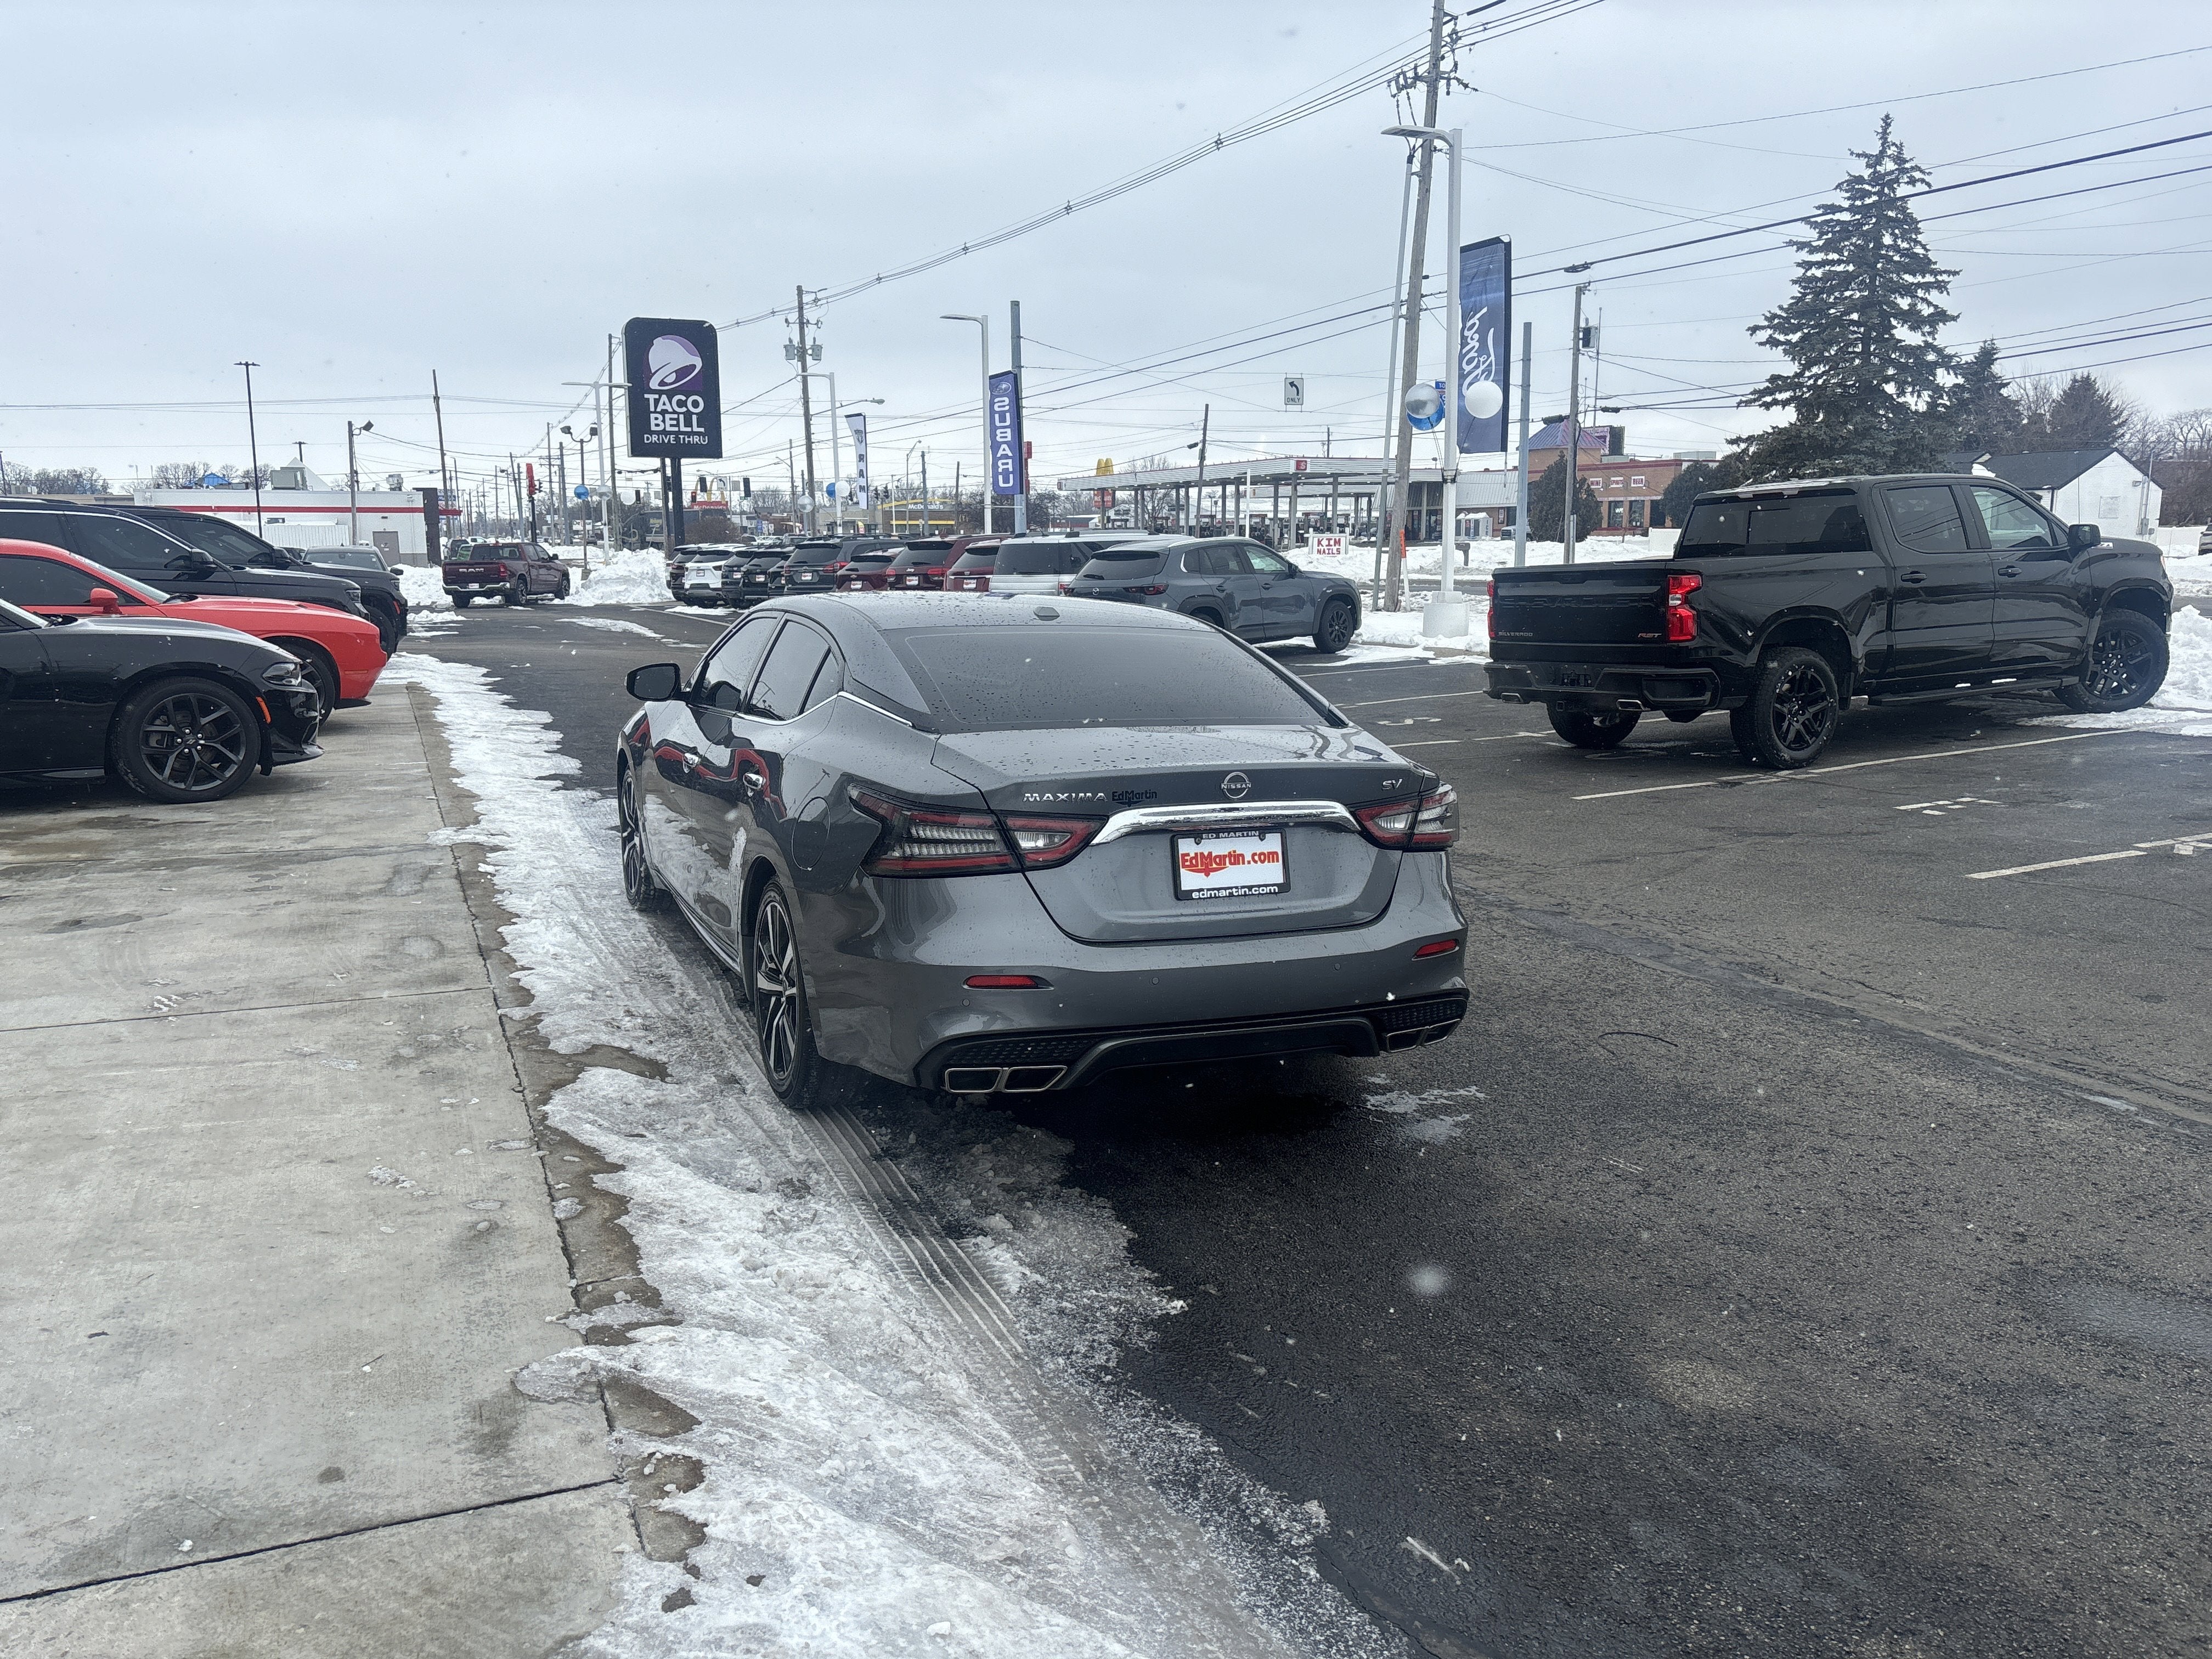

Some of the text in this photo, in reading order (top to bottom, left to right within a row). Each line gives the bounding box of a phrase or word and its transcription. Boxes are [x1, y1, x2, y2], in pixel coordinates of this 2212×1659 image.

[644, 393, 704, 413] TACO
[650, 413, 705, 432] BELL
[644, 434, 708, 445] DRIVE THRU
[1317, 538, 1341, 547] KIM
[1382, 778, 1403, 790] SV
[1023, 793, 1108, 802] MAXIMA
[1111, 789, 1158, 802] EdMartin
[1180, 849, 1280, 870] EdMartin.com
[1192, 885, 1279, 899] edmartin.com
